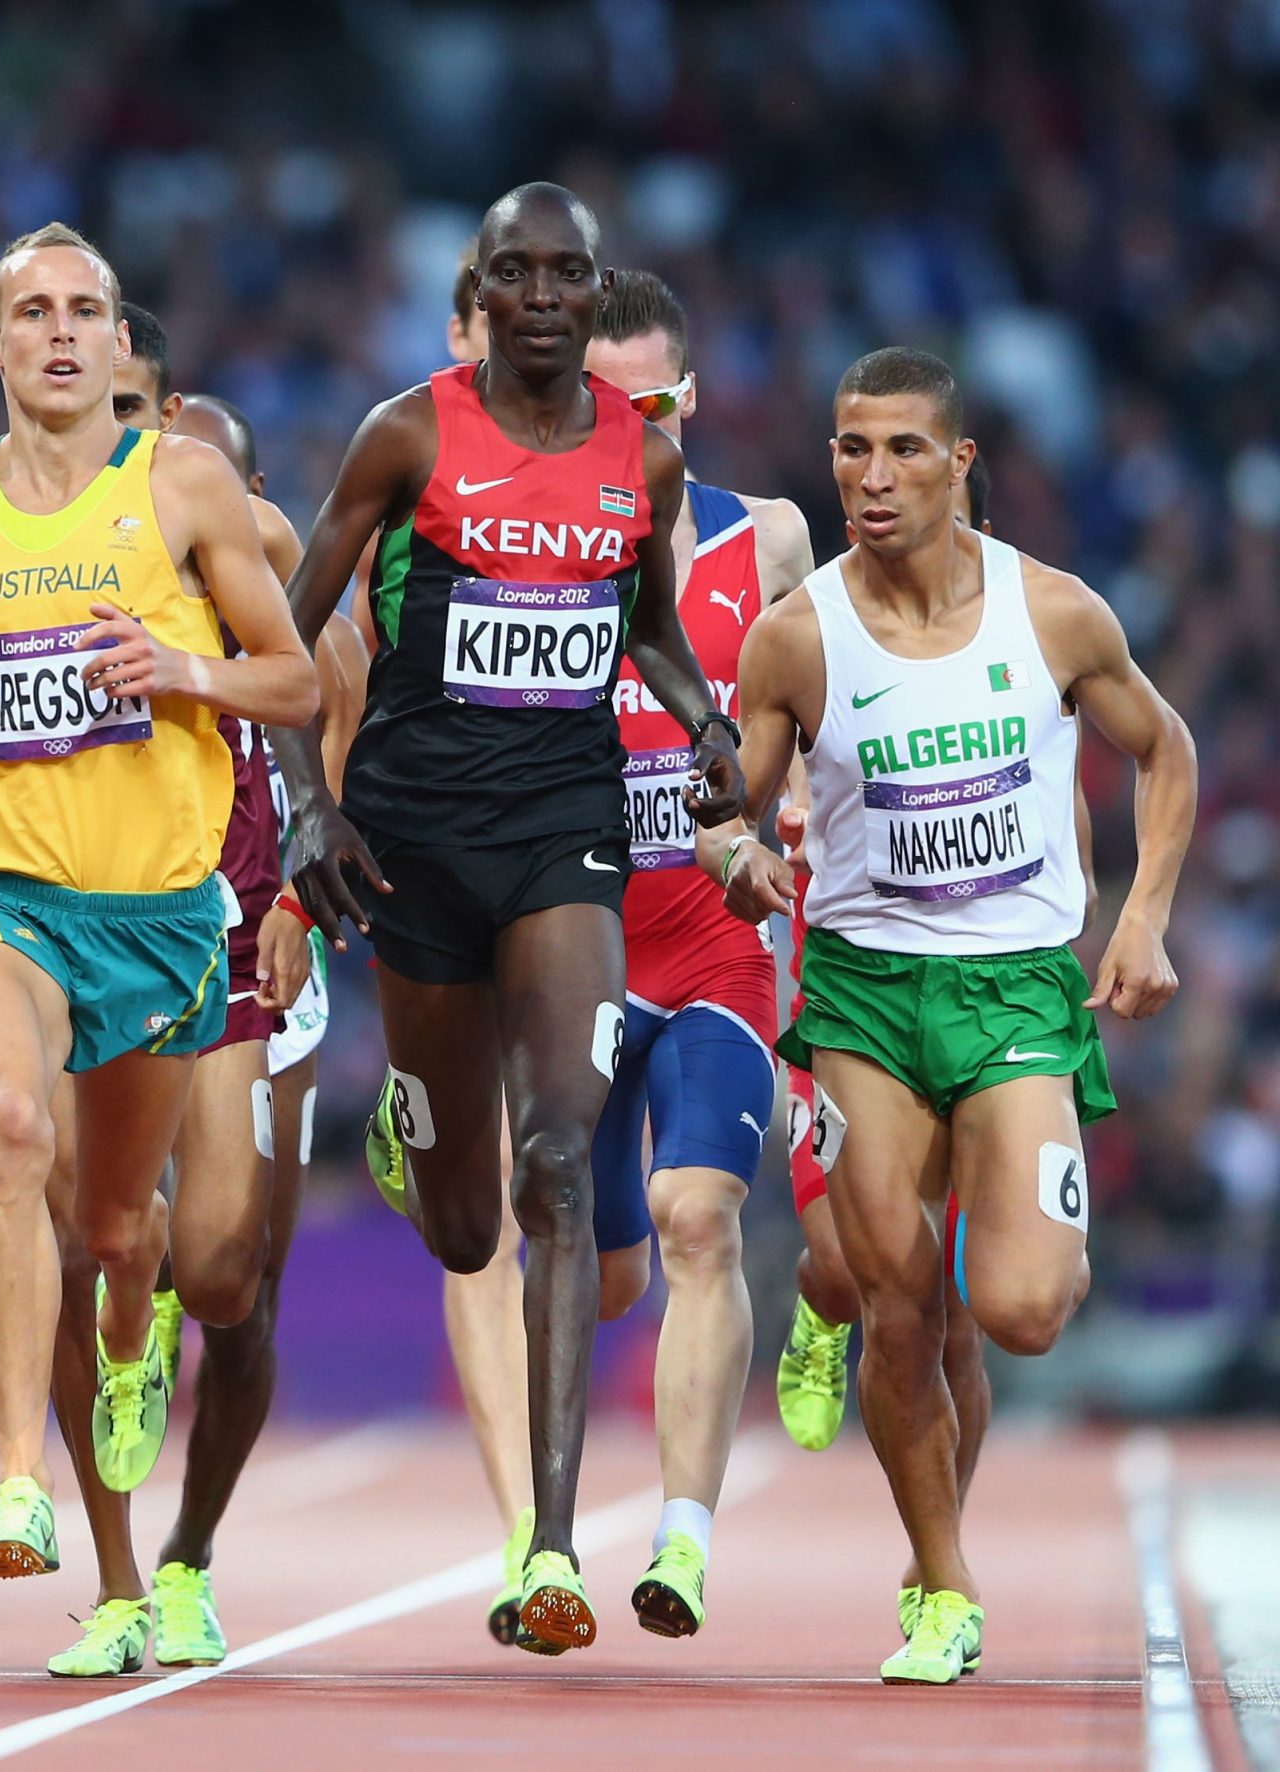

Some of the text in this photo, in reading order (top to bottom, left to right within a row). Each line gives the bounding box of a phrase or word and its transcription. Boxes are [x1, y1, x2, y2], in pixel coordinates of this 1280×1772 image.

[460, 516, 624, 562] KENYA
[496, 586, 591, 605] London 2012
[1, 635, 55, 655] London
[456, 618, 613, 679] KIPROP
[655, 752, 690, 770] 2012
[857, 716, 1026, 780] ALGERIA
[902, 778, 998, 806] London 2012
[889, 801, 1026, 876] MAKHLOUFI
[394, 1077, 416, 1140] 8
[1060, 1158, 1081, 1218] 6
